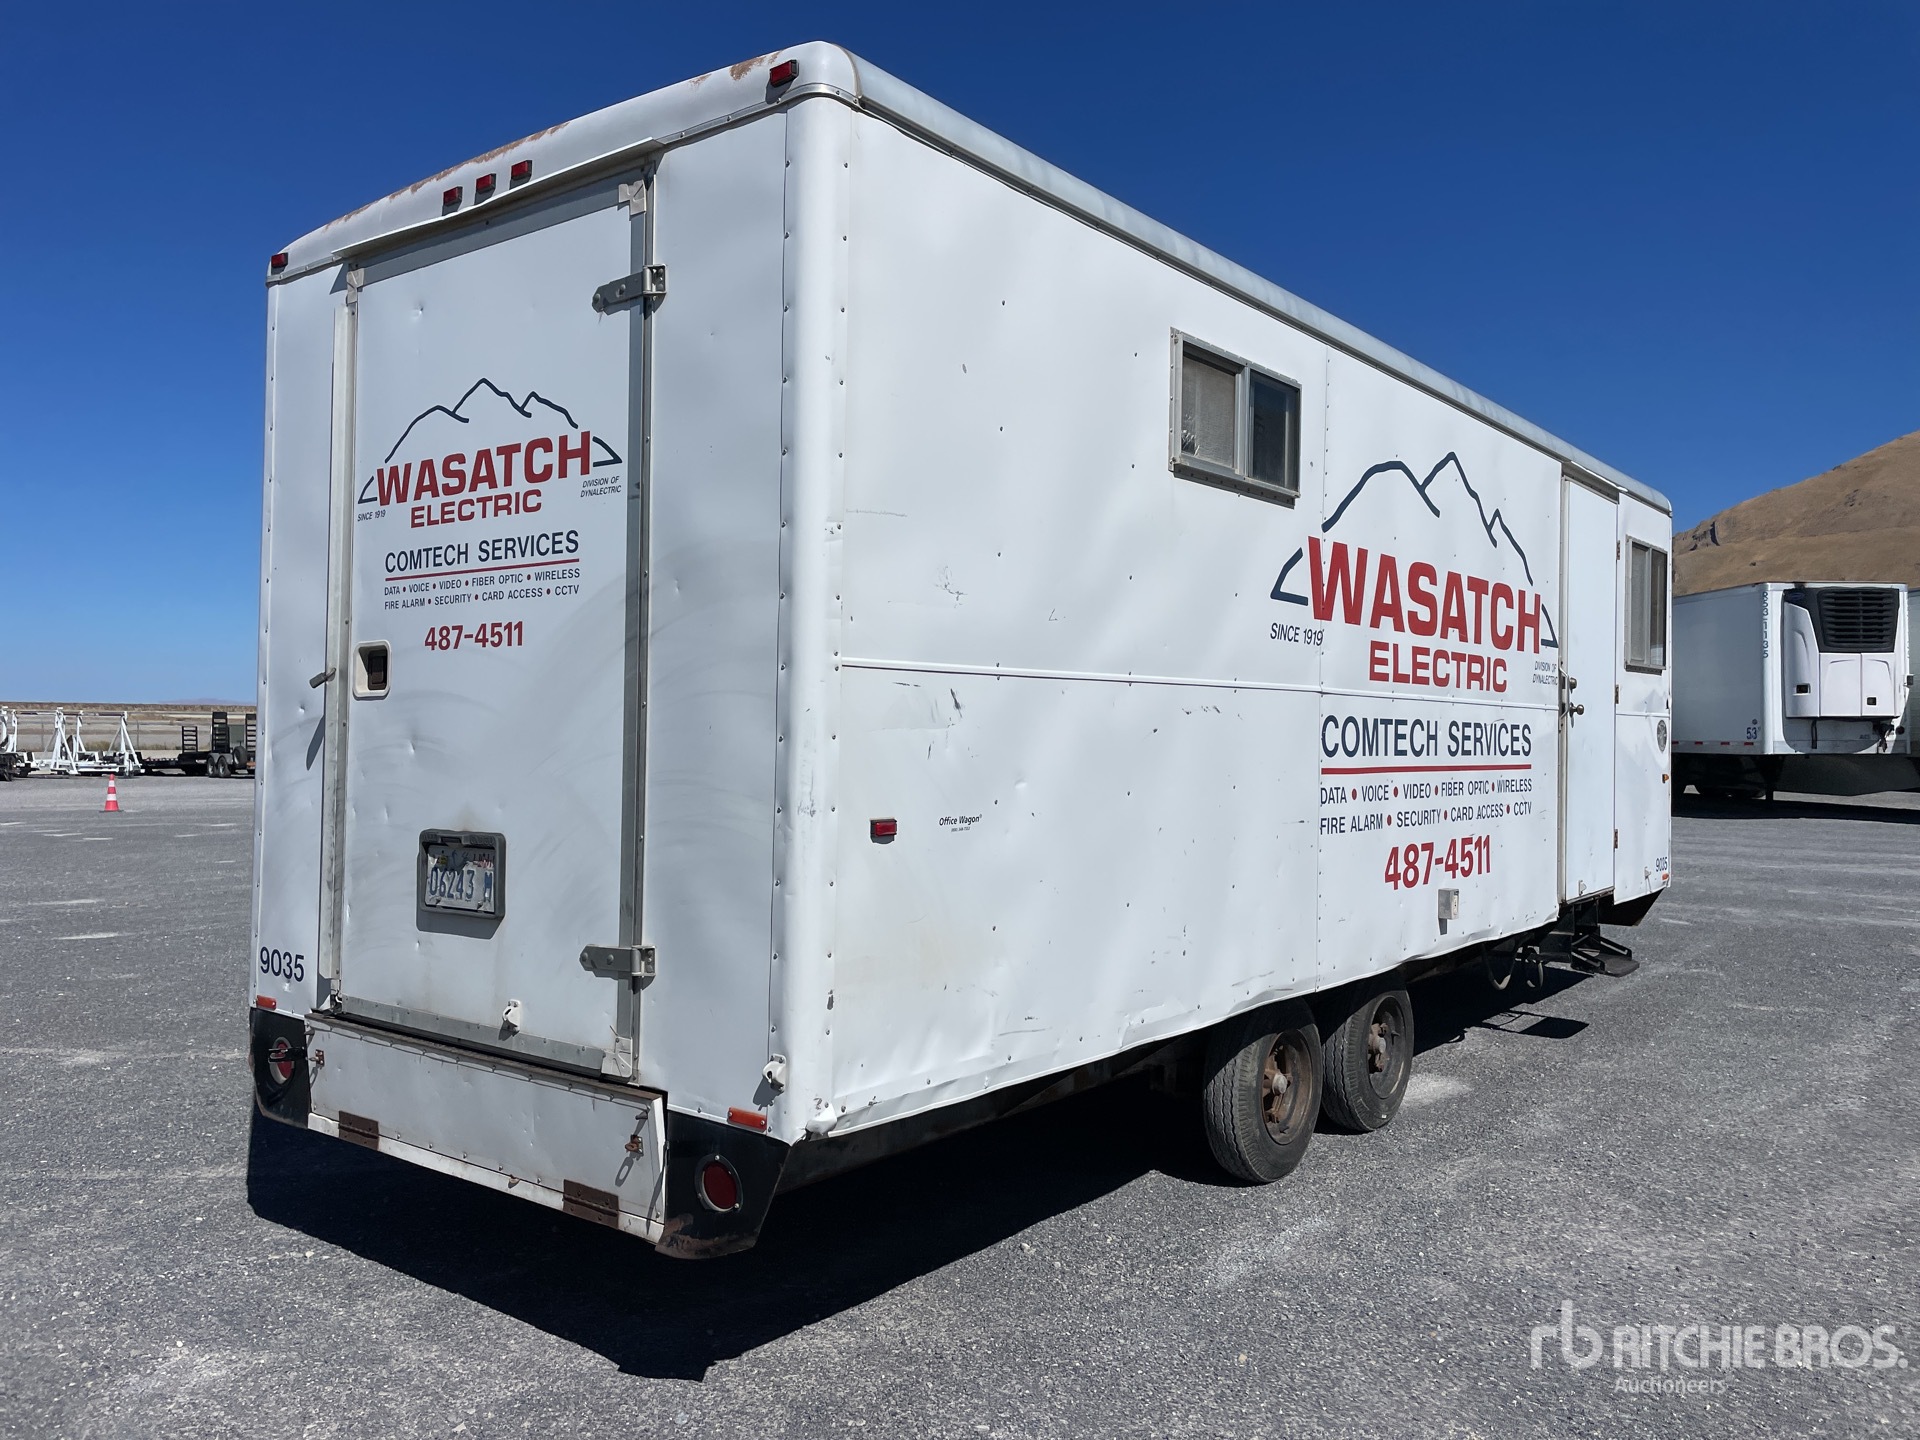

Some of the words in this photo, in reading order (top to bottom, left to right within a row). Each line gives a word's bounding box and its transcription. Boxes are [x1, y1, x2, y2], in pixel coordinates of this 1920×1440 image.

[377, 431, 591, 506] WASATCH
[582, 478, 608, 488] DIVISION
[610, 476, 620, 484] OF
[580, 485, 622, 498] DYNALECTRIC
[358, 512, 373, 521] SINCE
[375, 510, 386, 518] 1919
[411, 489, 542, 528] ELECTRIC
[385, 543, 469, 573] COMTECH
[478, 530, 579, 562] SERVICES
[384, 586, 400, 596] DATA
[409, 583, 430, 593] VOICE
[439, 580, 462, 590] VIDEO
[472, 576, 495, 587] FIBER
[499, 573, 523, 584] OPTIC
[535, 568, 580, 581] WIRELESS
[385, 600, 399, 610] FIRE
[402, 598, 425, 608] ALARM
[434, 594, 472, 605] SECURITY
[482, 591, 504, 602] CARD
[508, 588, 543, 599] ACCESS
[555, 585, 579, 596] CCTV
[1308, 536, 1541, 654] WASATCH
[424, 621, 523, 651] 487-4511
[1270, 622, 1300, 642] SINCE
[1303, 628, 1324, 646] 1919
[1369, 640, 1507, 693] ELECTRIC
[1321, 715, 1438, 757] COMTECH
[1447, 720, 1532, 757] SERVICES
[1320, 787, 1347, 805] DATA
[1362, 785, 1389, 802] VOICE
[1403, 783, 1431, 799] VIDEO
[1441, 782, 1464, 797] FIBER
[1468, 780, 1489, 795] OPTIC
[1497, 779, 1532, 793] WIRELESS
[939, 816, 957, 826] Office
[1320, 817, 1346, 835] FIRE
[1350, 813, 1383, 832] ALARM
[1397, 809, 1441, 828] SECURITY
[1451, 806, 1473, 822] CARD
[1476, 804, 1504, 820] ACCESS
[1514, 802, 1532, 816] CCTV
[1384, 835, 1490, 890] 487-4511
[260, 947, 304, 982] 9035
